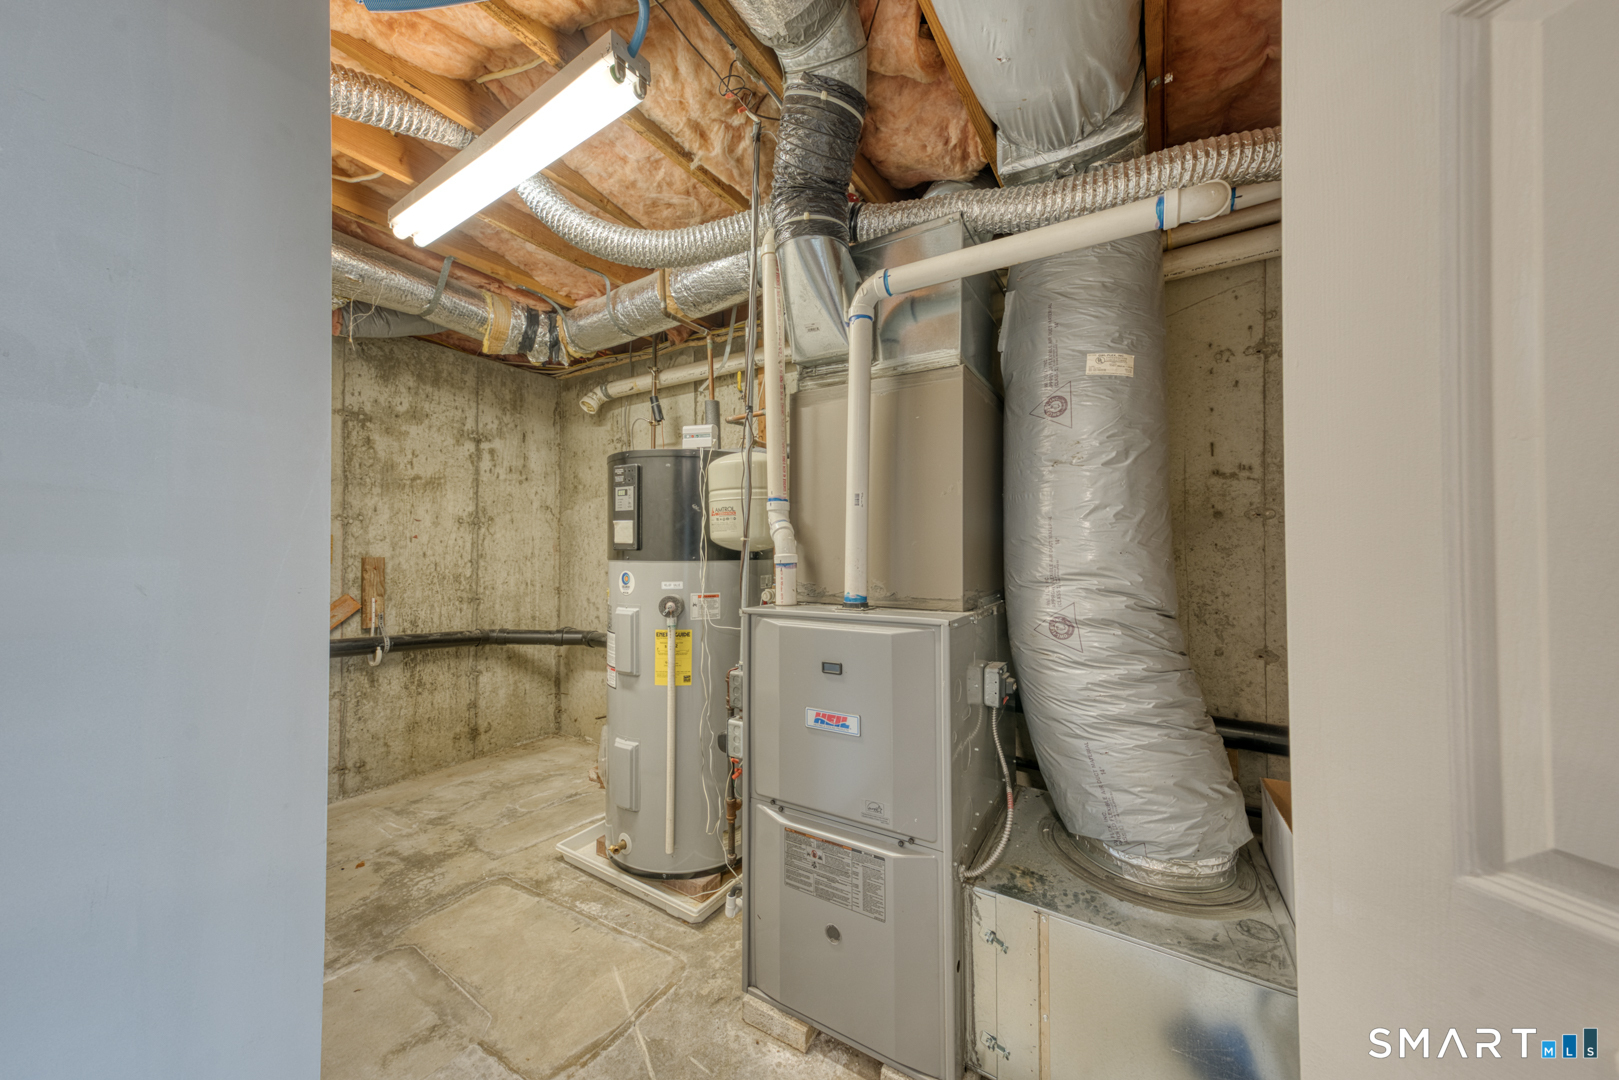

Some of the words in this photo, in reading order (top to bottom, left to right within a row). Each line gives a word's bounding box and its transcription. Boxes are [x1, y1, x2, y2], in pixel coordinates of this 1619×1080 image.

[715, 505, 735, 513] AMTROL
[1084, 742, 1096, 768] MATERIAL
[1092, 769, 1102, 784] DUCT
[1098, 785, 1106, 795] AIR
[1102, 796, 1114, 822] FLEXIBLE
